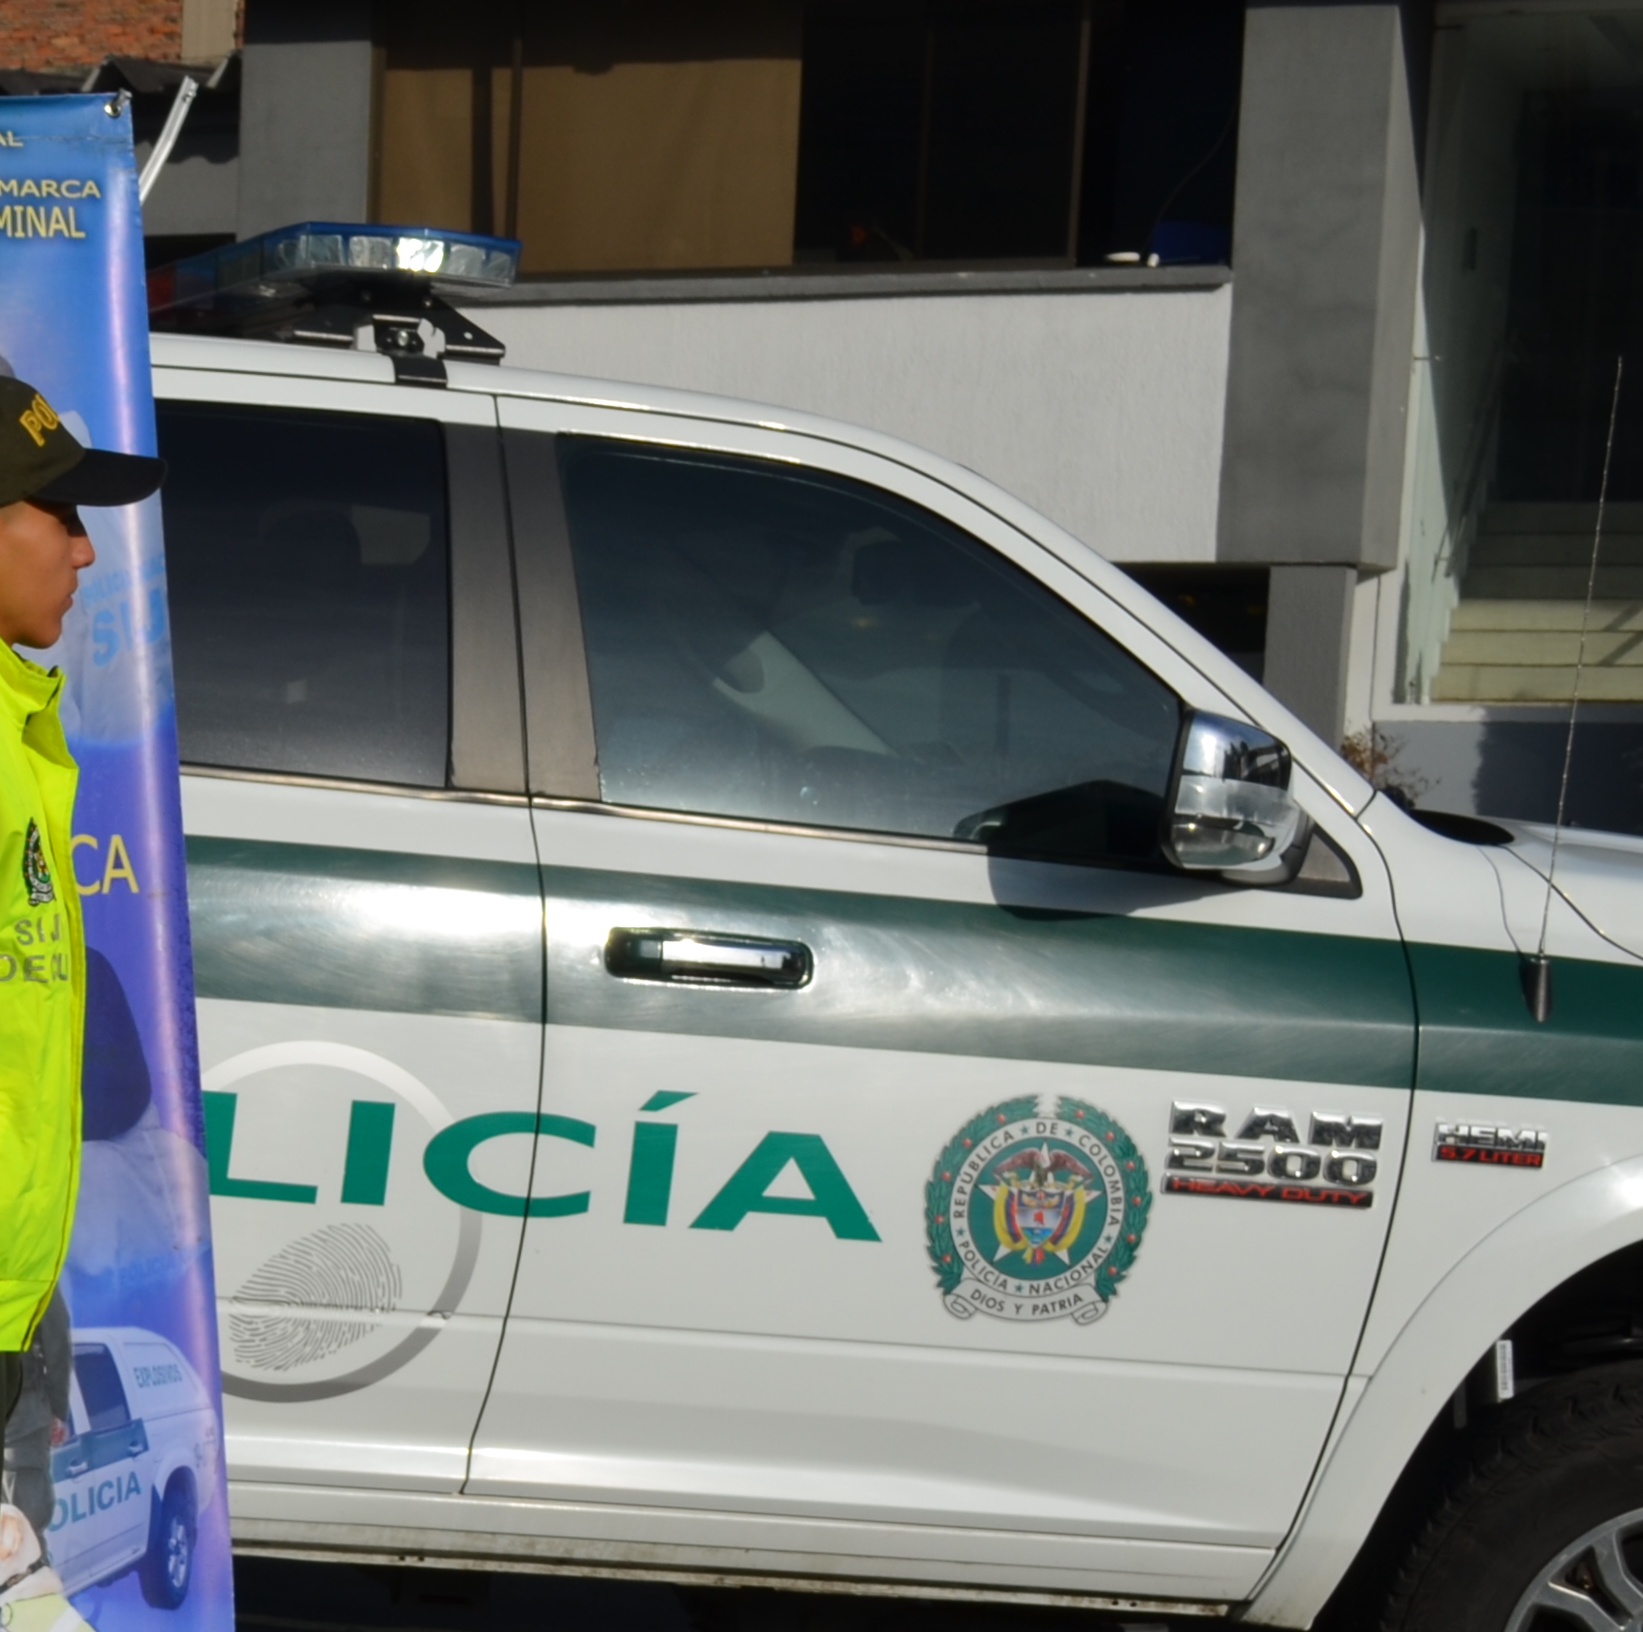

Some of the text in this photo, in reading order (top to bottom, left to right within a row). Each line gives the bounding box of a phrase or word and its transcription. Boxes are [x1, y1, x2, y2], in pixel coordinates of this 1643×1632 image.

[1168, 1099, 1384, 1150] RAM
[1434, 1119, 1549, 1151] HEMI
[1035, 1121, 1059, 1136] DE
[1078, 1134, 1123, 1227] COLOMBIA
[1165, 1136, 1378, 1186] 2500
[1440, 1146, 1543, 1167] 5.7 LITER
[1172, 1174, 1371, 1205] HEAVY DUTY
[1027, 1245, 1109, 1295] NACIONAL
[969, 1287, 1084, 1316] DIOS Y PATRIA
